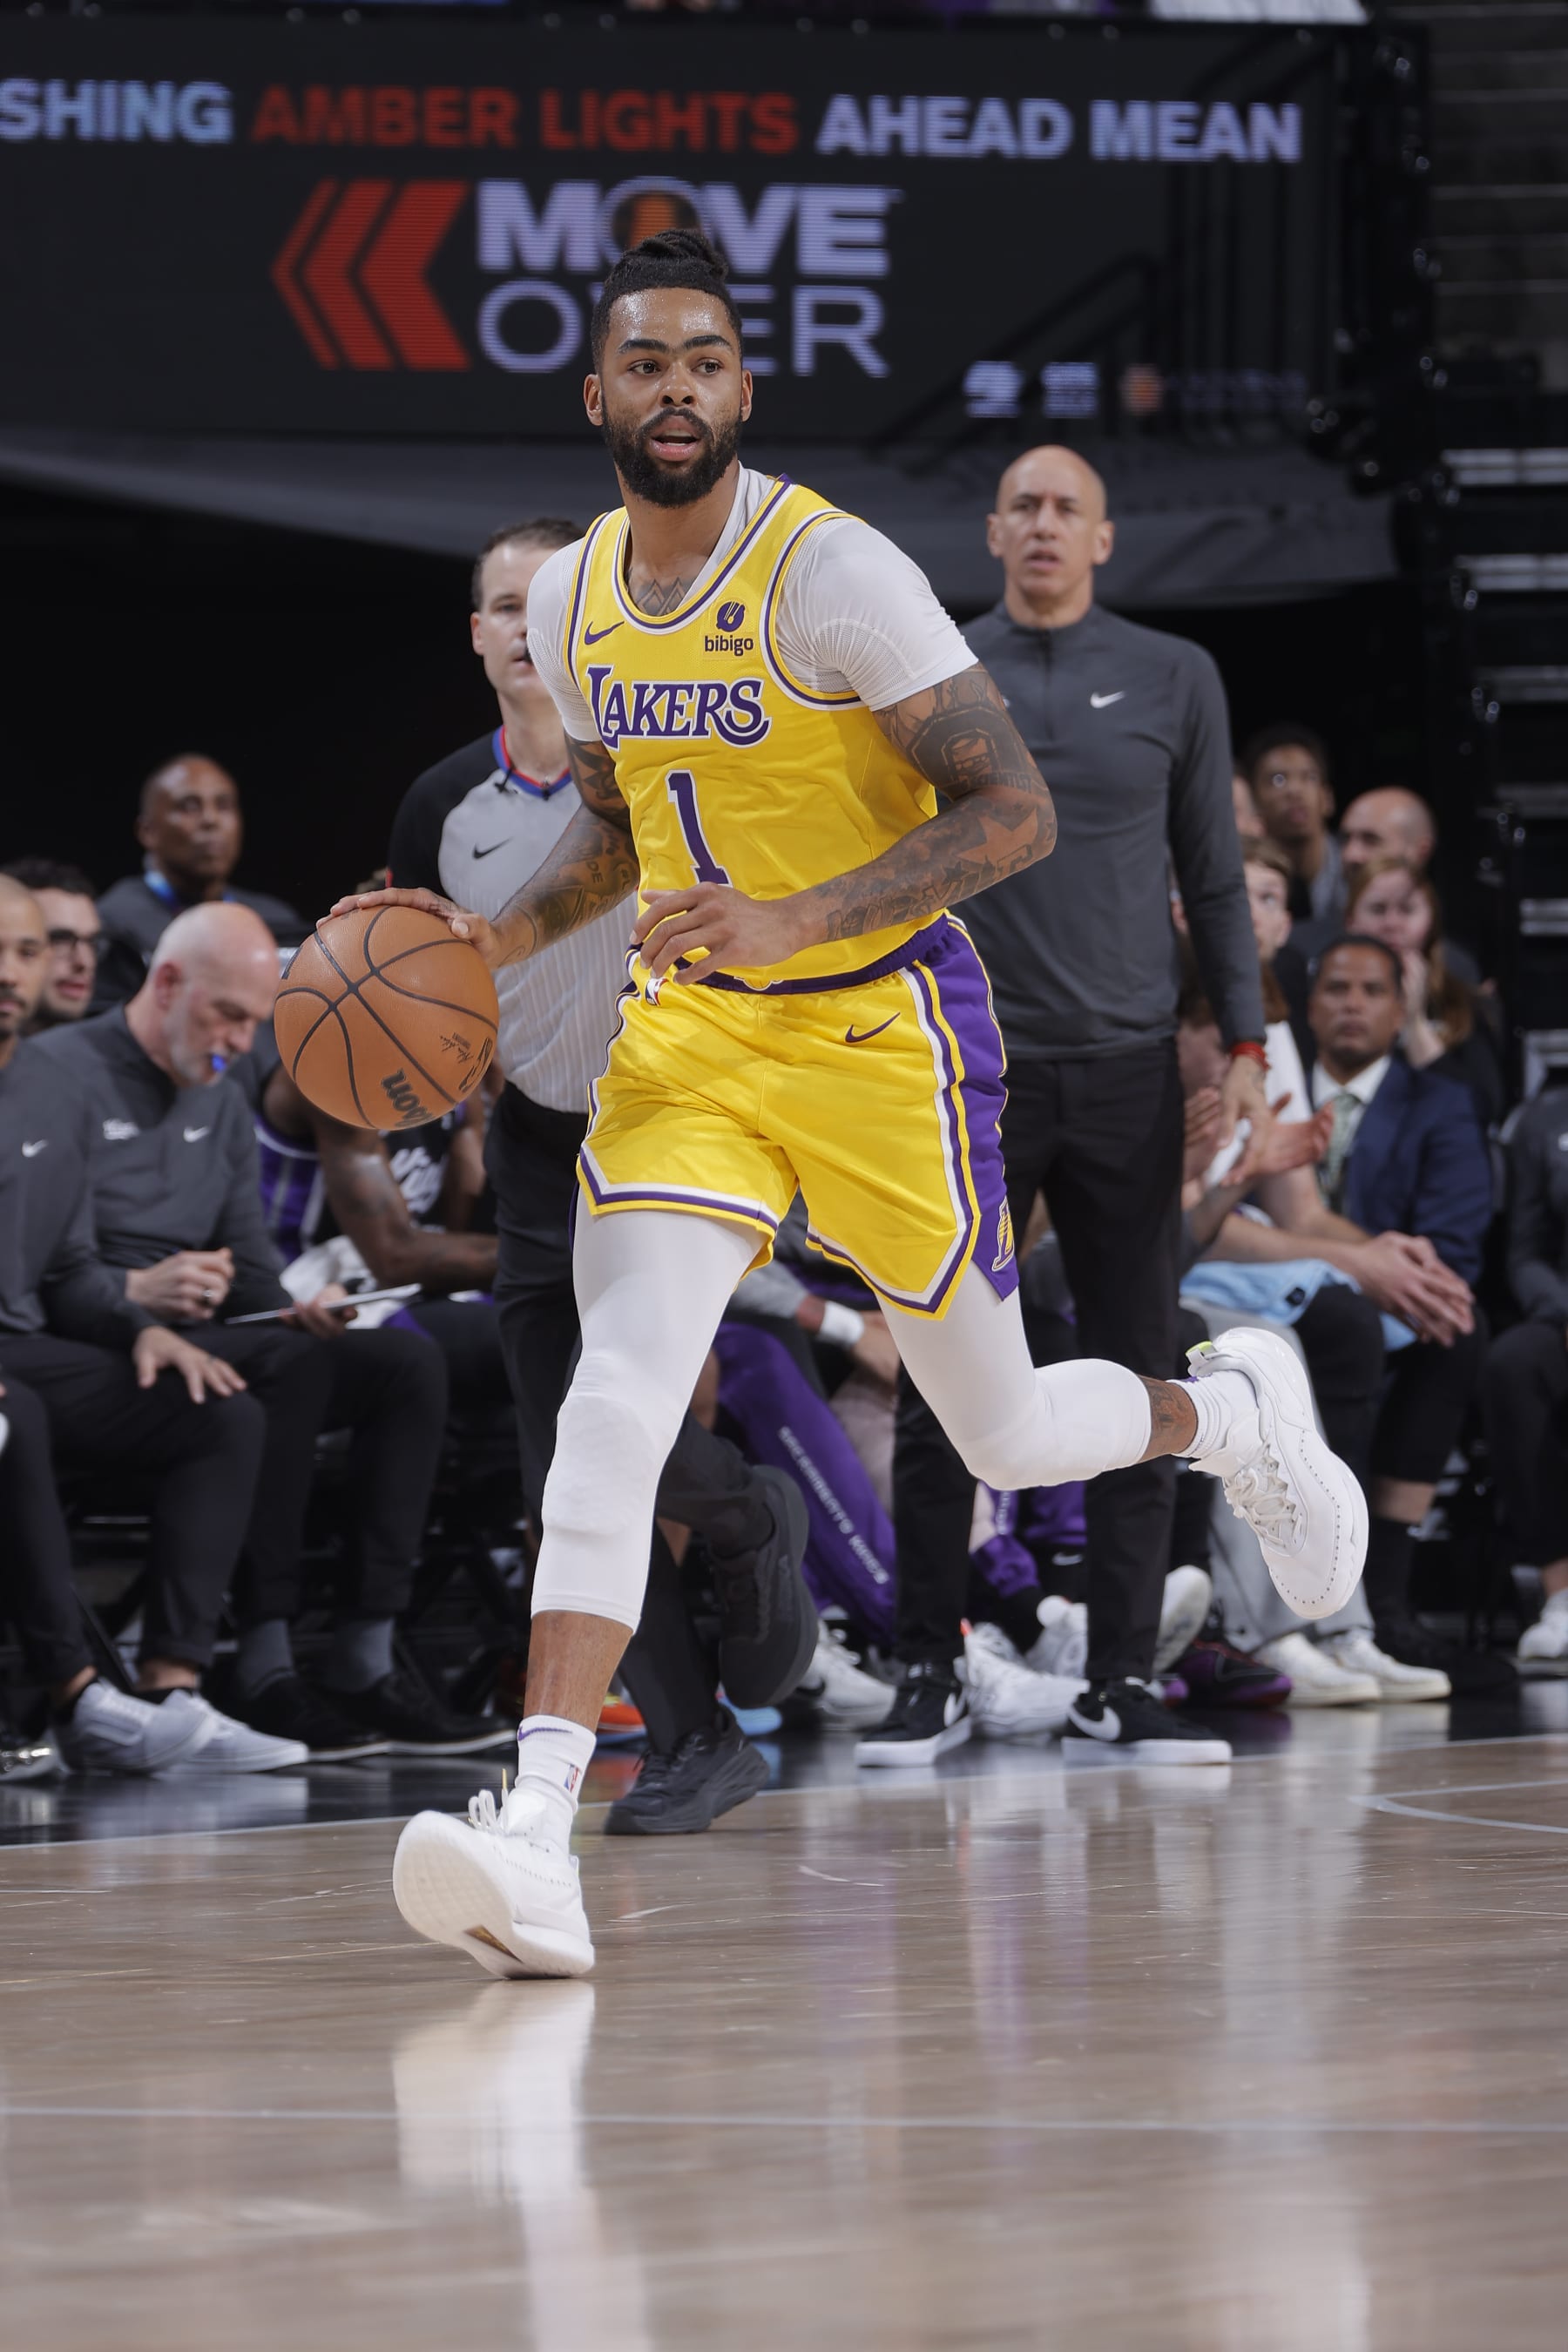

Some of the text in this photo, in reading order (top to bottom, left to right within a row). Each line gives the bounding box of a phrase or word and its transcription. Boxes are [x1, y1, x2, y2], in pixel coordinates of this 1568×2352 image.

[0, 78, 1301, 163] SHING AMBER LIGHTS AHEAD MEAN
[478, 280, 890, 378] OER
[704, 635, 755, 657] bibigo
[586, 663, 773, 751] LAKERS
[666, 768, 732, 887] 1
